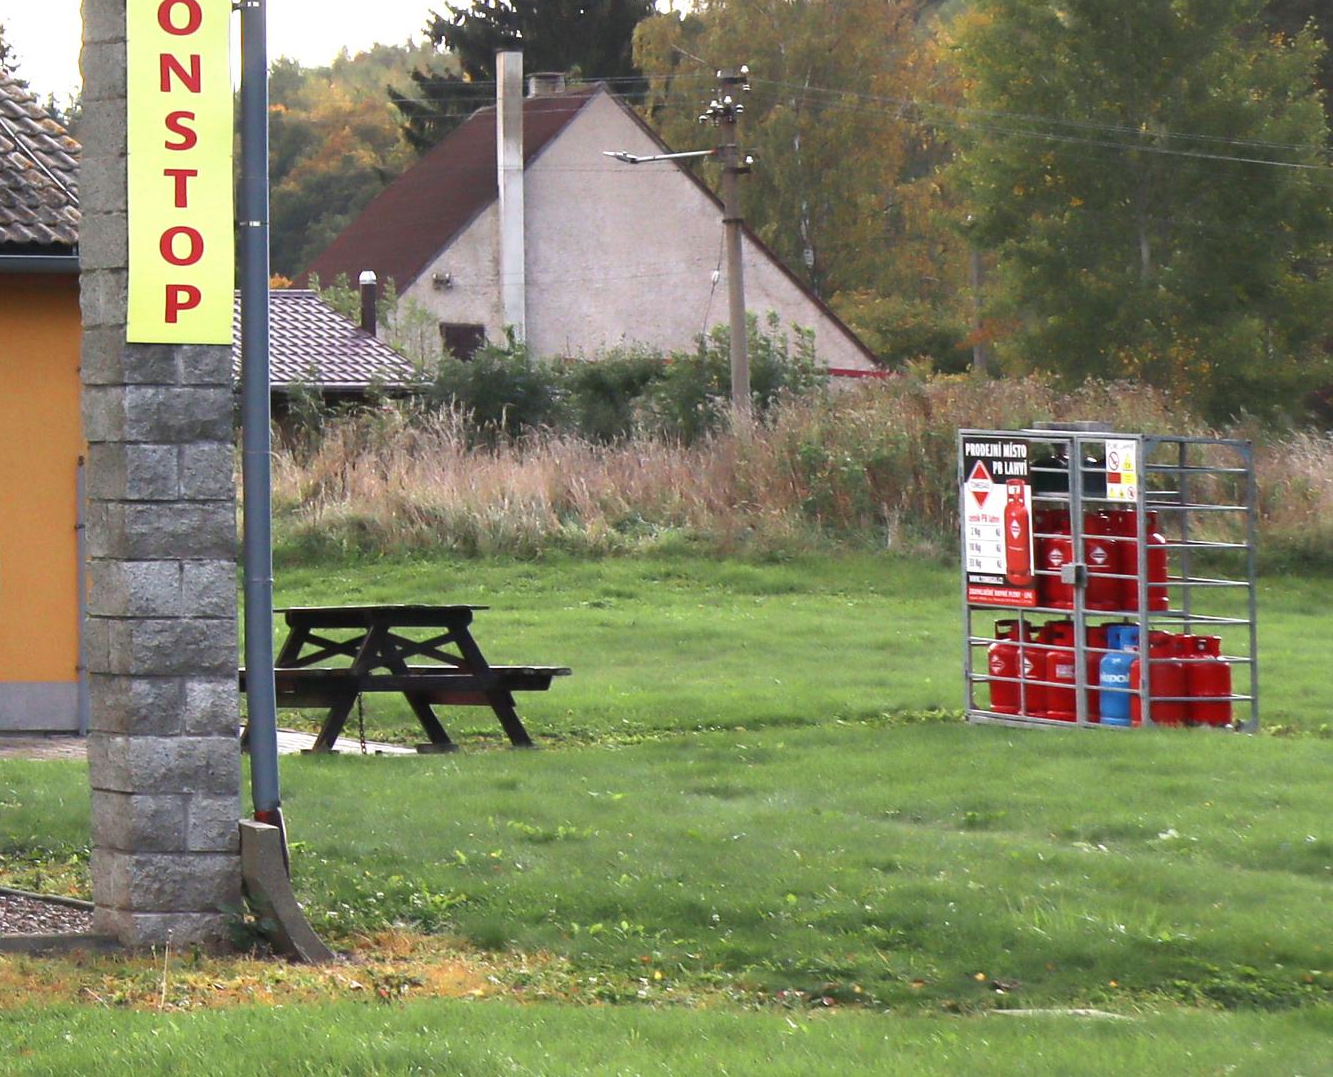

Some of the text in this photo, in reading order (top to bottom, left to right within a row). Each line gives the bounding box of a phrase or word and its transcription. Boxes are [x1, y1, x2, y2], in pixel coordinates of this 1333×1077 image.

[965, 442, 1027, 458] PRODEJNÍ MÍSTO
[993, 460, 1027, 475] PB LAHVÍ
